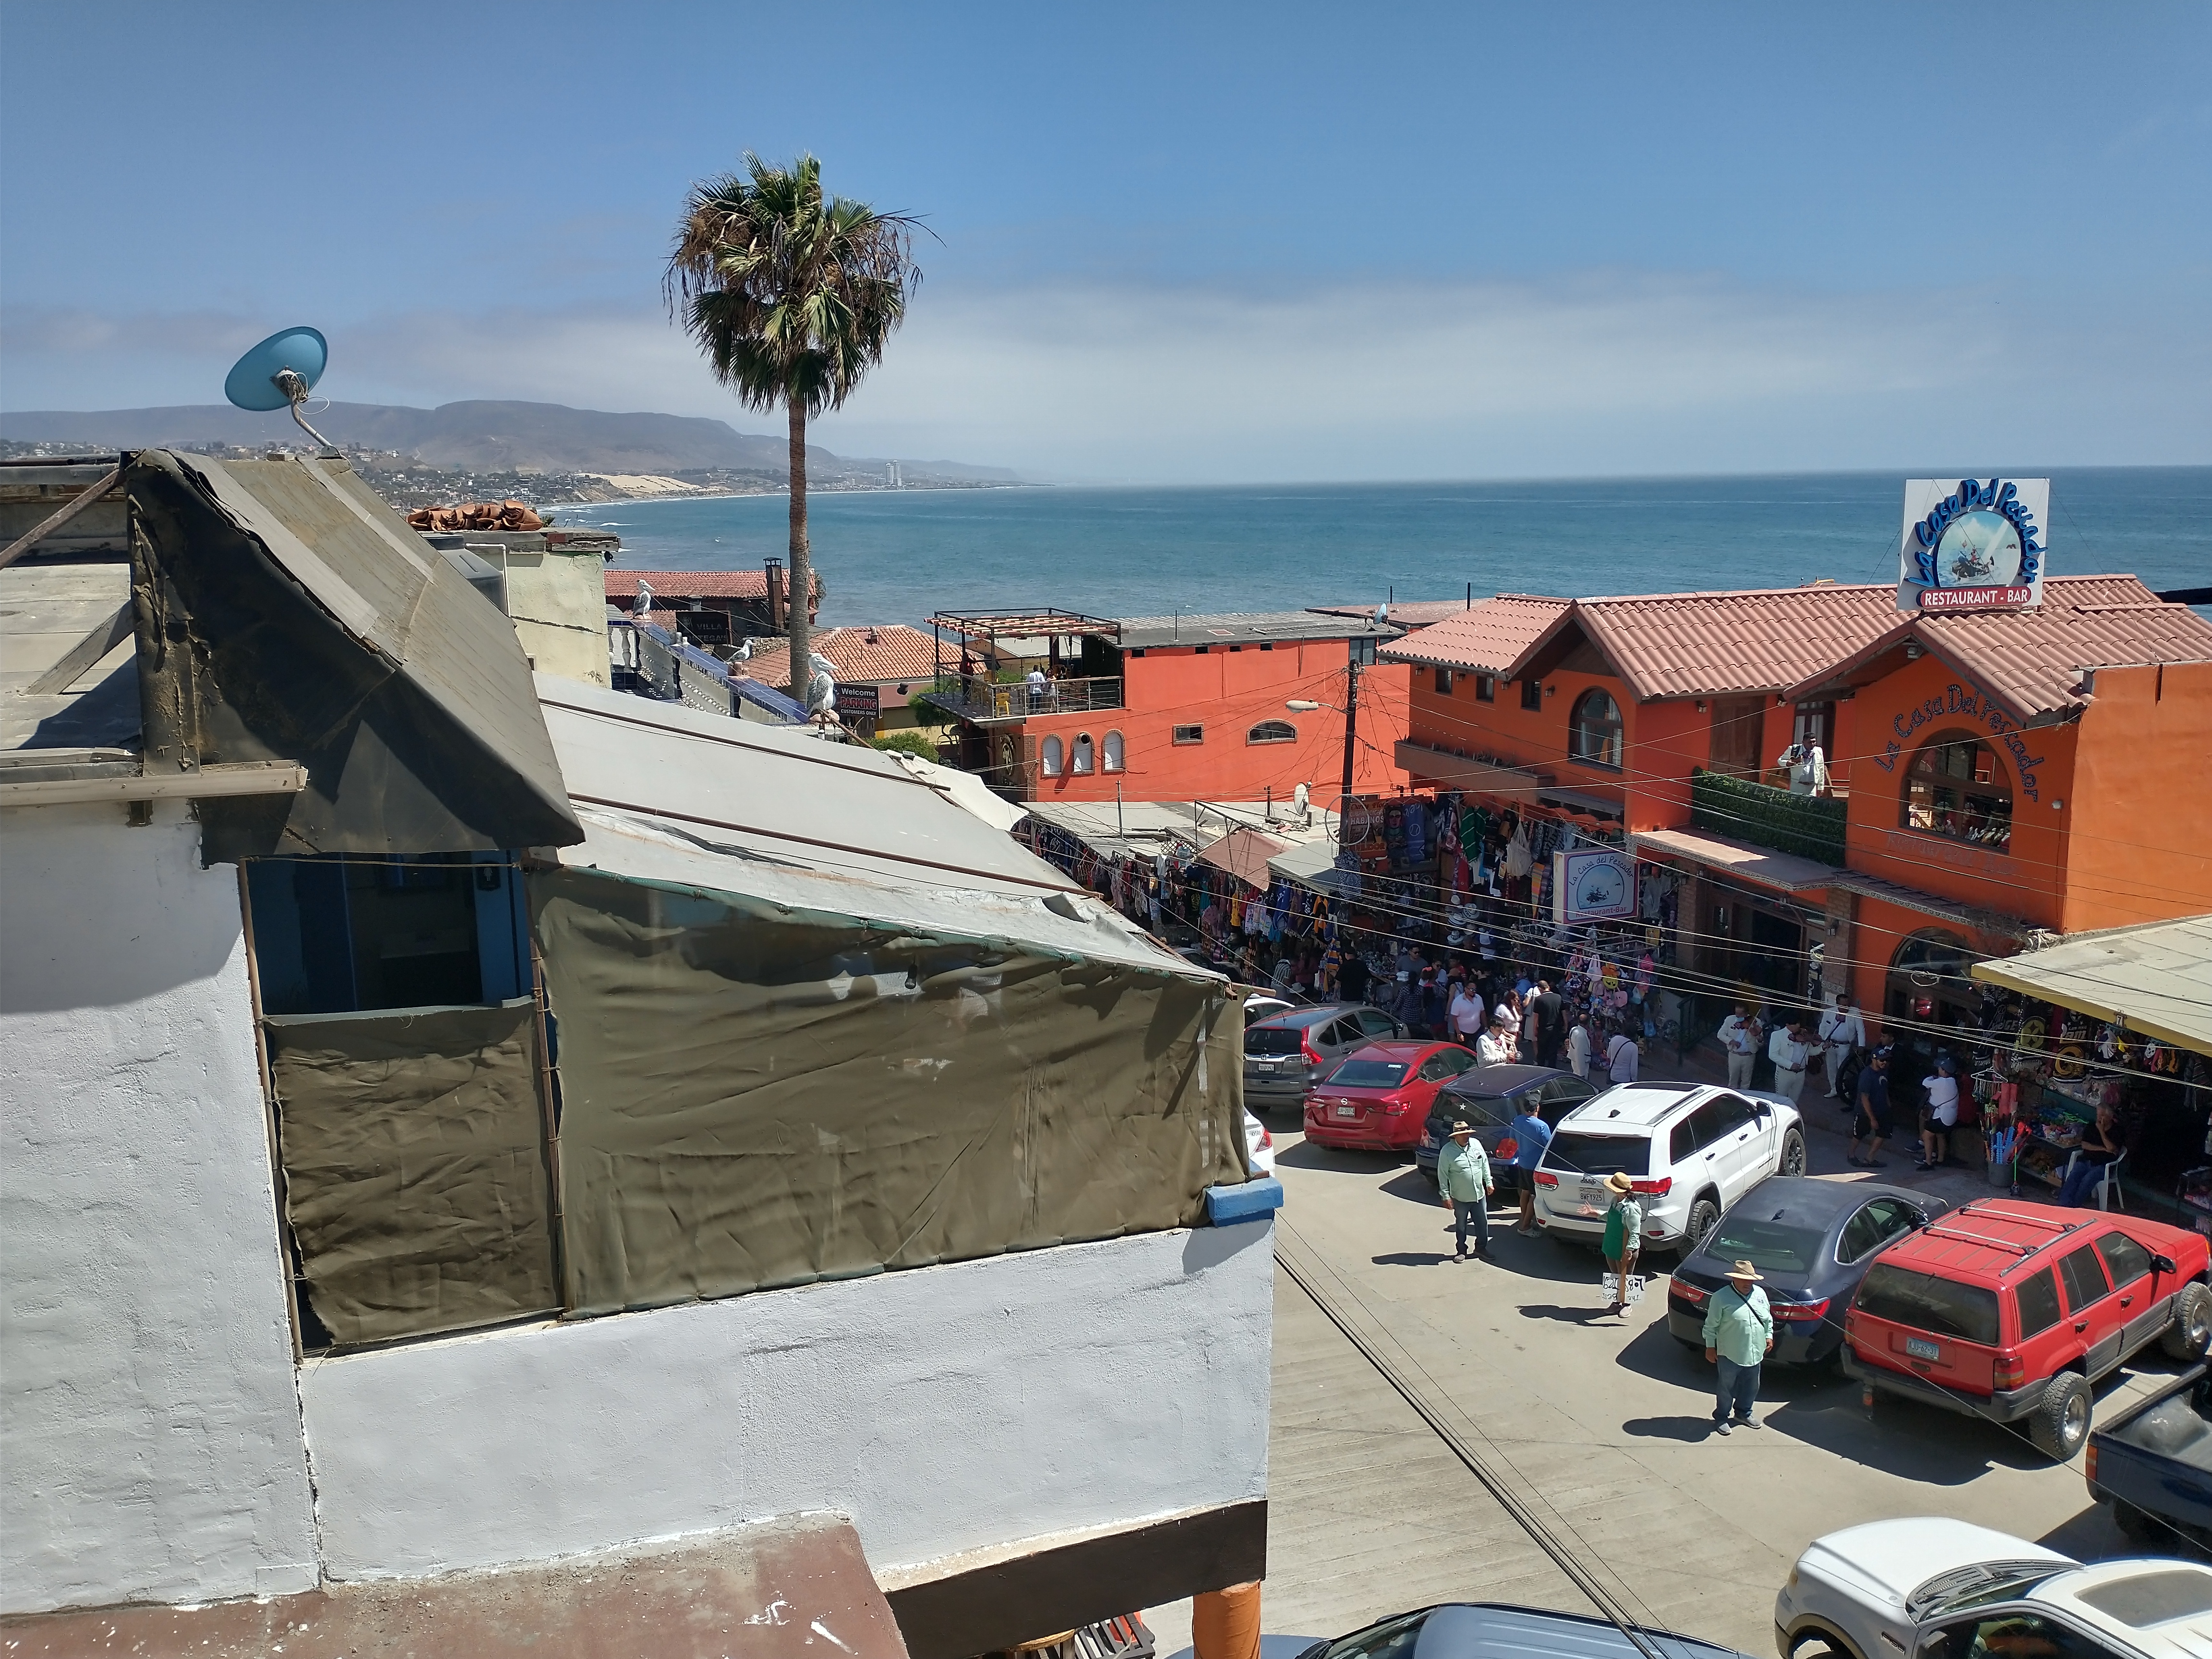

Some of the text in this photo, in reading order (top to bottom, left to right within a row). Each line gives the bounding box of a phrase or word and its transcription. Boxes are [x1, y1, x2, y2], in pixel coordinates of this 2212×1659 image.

[1904, 478, 2048, 588] La Casa Del Pescador
[1924, 590, 1998, 606] RESTAURANT
[2007, 589, 2028, 602] BAR
[841, 687, 876, 697] Welcome
[840, 697, 878, 710] PARKING
[1874, 684, 2044, 802] La Casa Del Pescador
[1350, 816, 1384, 825] HABANOS
[1568, 855, 1633, 885] La Casa del Pescador
[2117, 1016, 2122, 1024] 7
[1580, 1177, 1596, 1185] Jeep
[1580, 1193, 1602, 1201] 8WFY925
